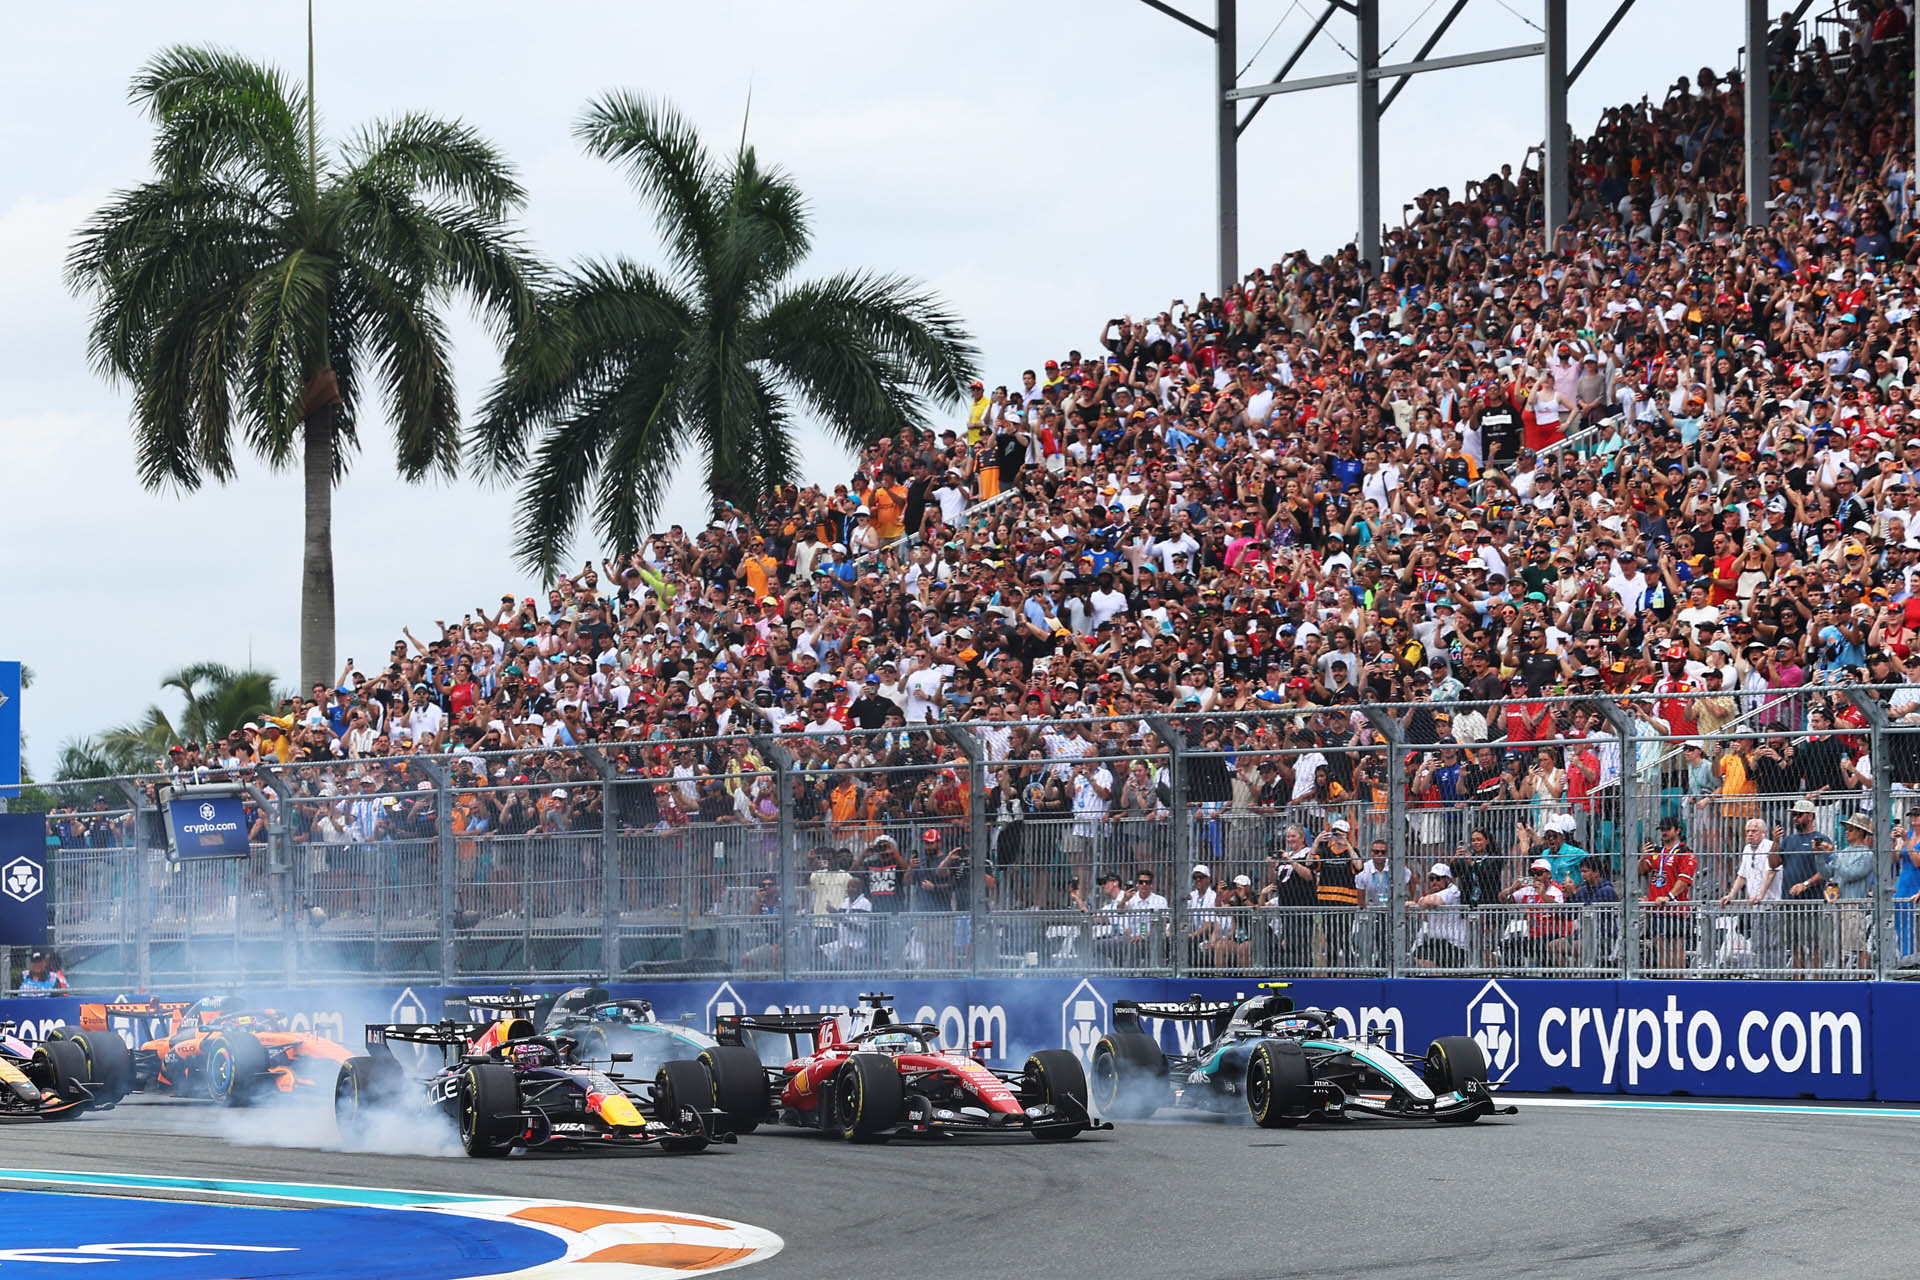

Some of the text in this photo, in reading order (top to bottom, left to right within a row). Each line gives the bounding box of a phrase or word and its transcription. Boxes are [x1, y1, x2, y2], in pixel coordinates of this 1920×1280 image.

[184, 822, 237, 834] crypto.com
[819, 1024, 834, 1049] 16
[1538, 995, 1862, 1085] crypto.com
[554, 1122, 586, 1132] VISA
